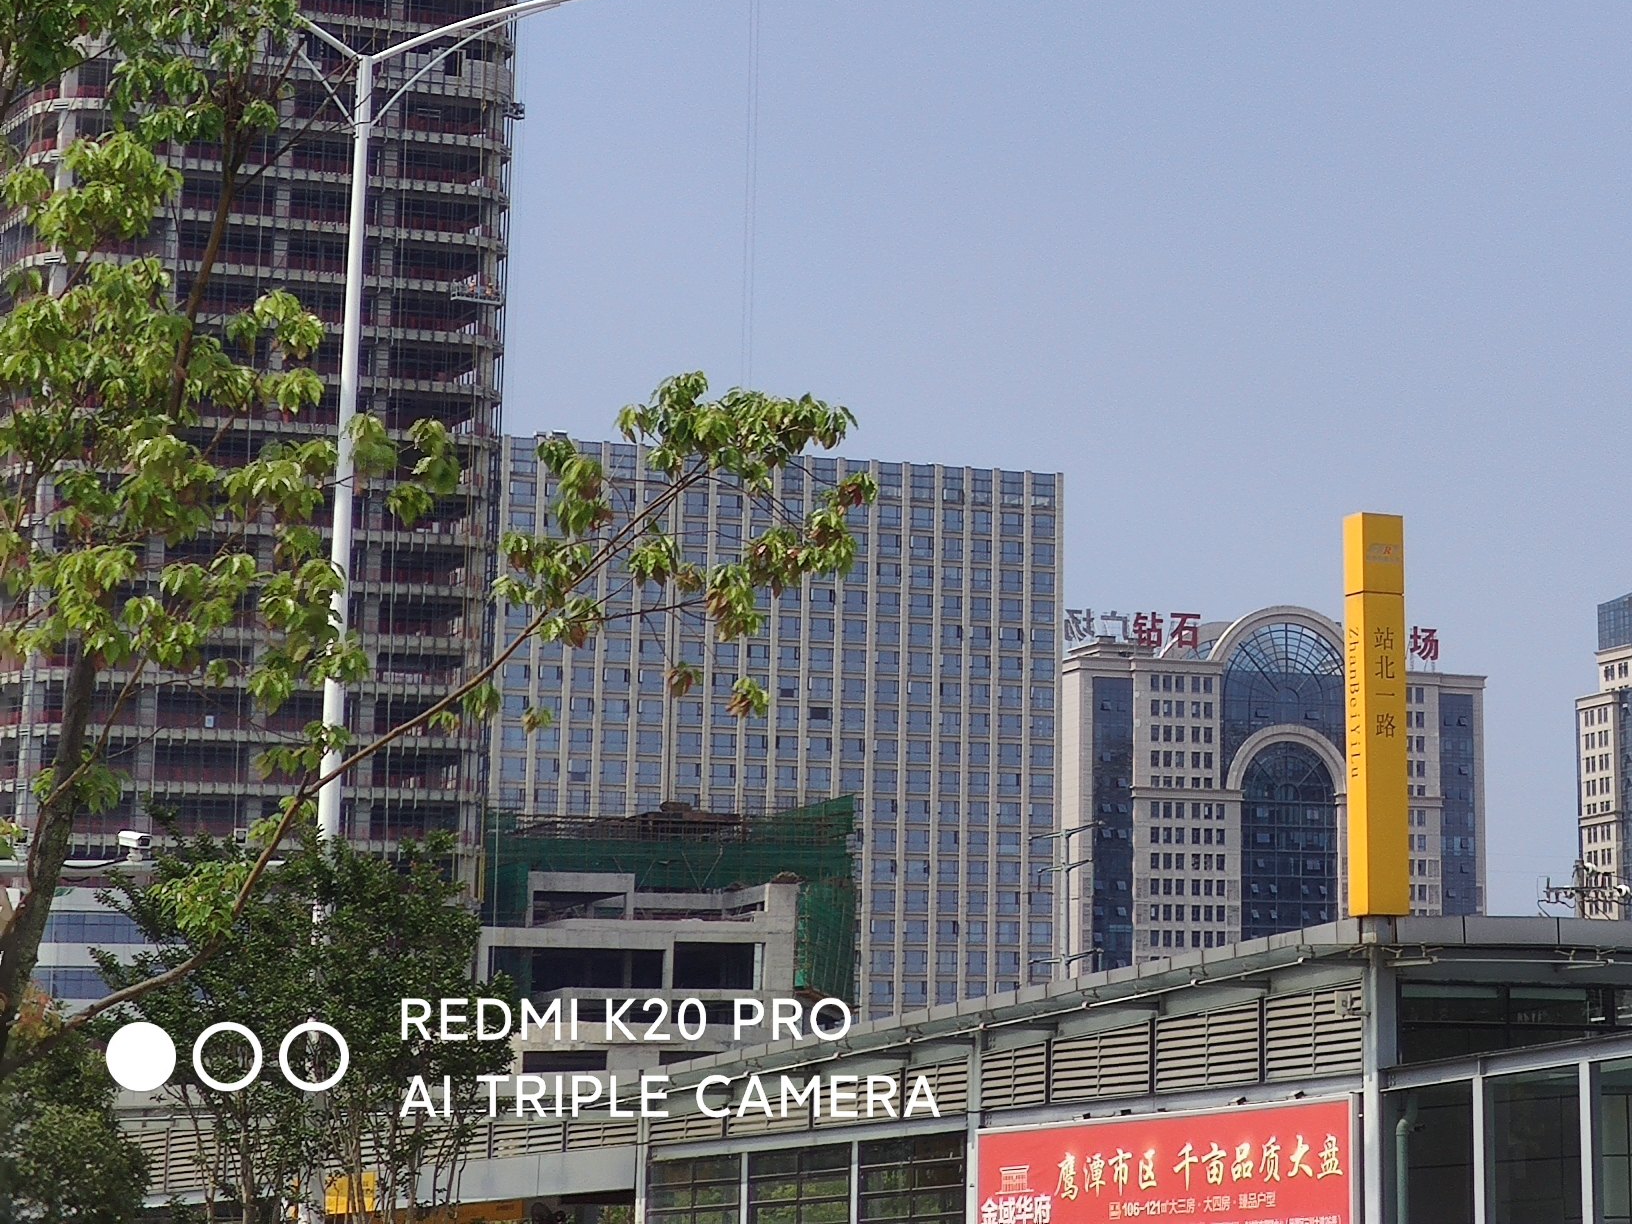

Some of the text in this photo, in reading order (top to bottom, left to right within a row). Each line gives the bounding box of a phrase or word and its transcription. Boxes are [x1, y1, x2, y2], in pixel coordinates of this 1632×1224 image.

[1132, 611, 1440, 661] 钻石 场
[1373, 626, 1396, 739] 站北一路
[1054, 1132, 1344, 1201] 鹰潭市区 千亩品质大盘
[980, 1193, 1052, 1224] 金域华府
